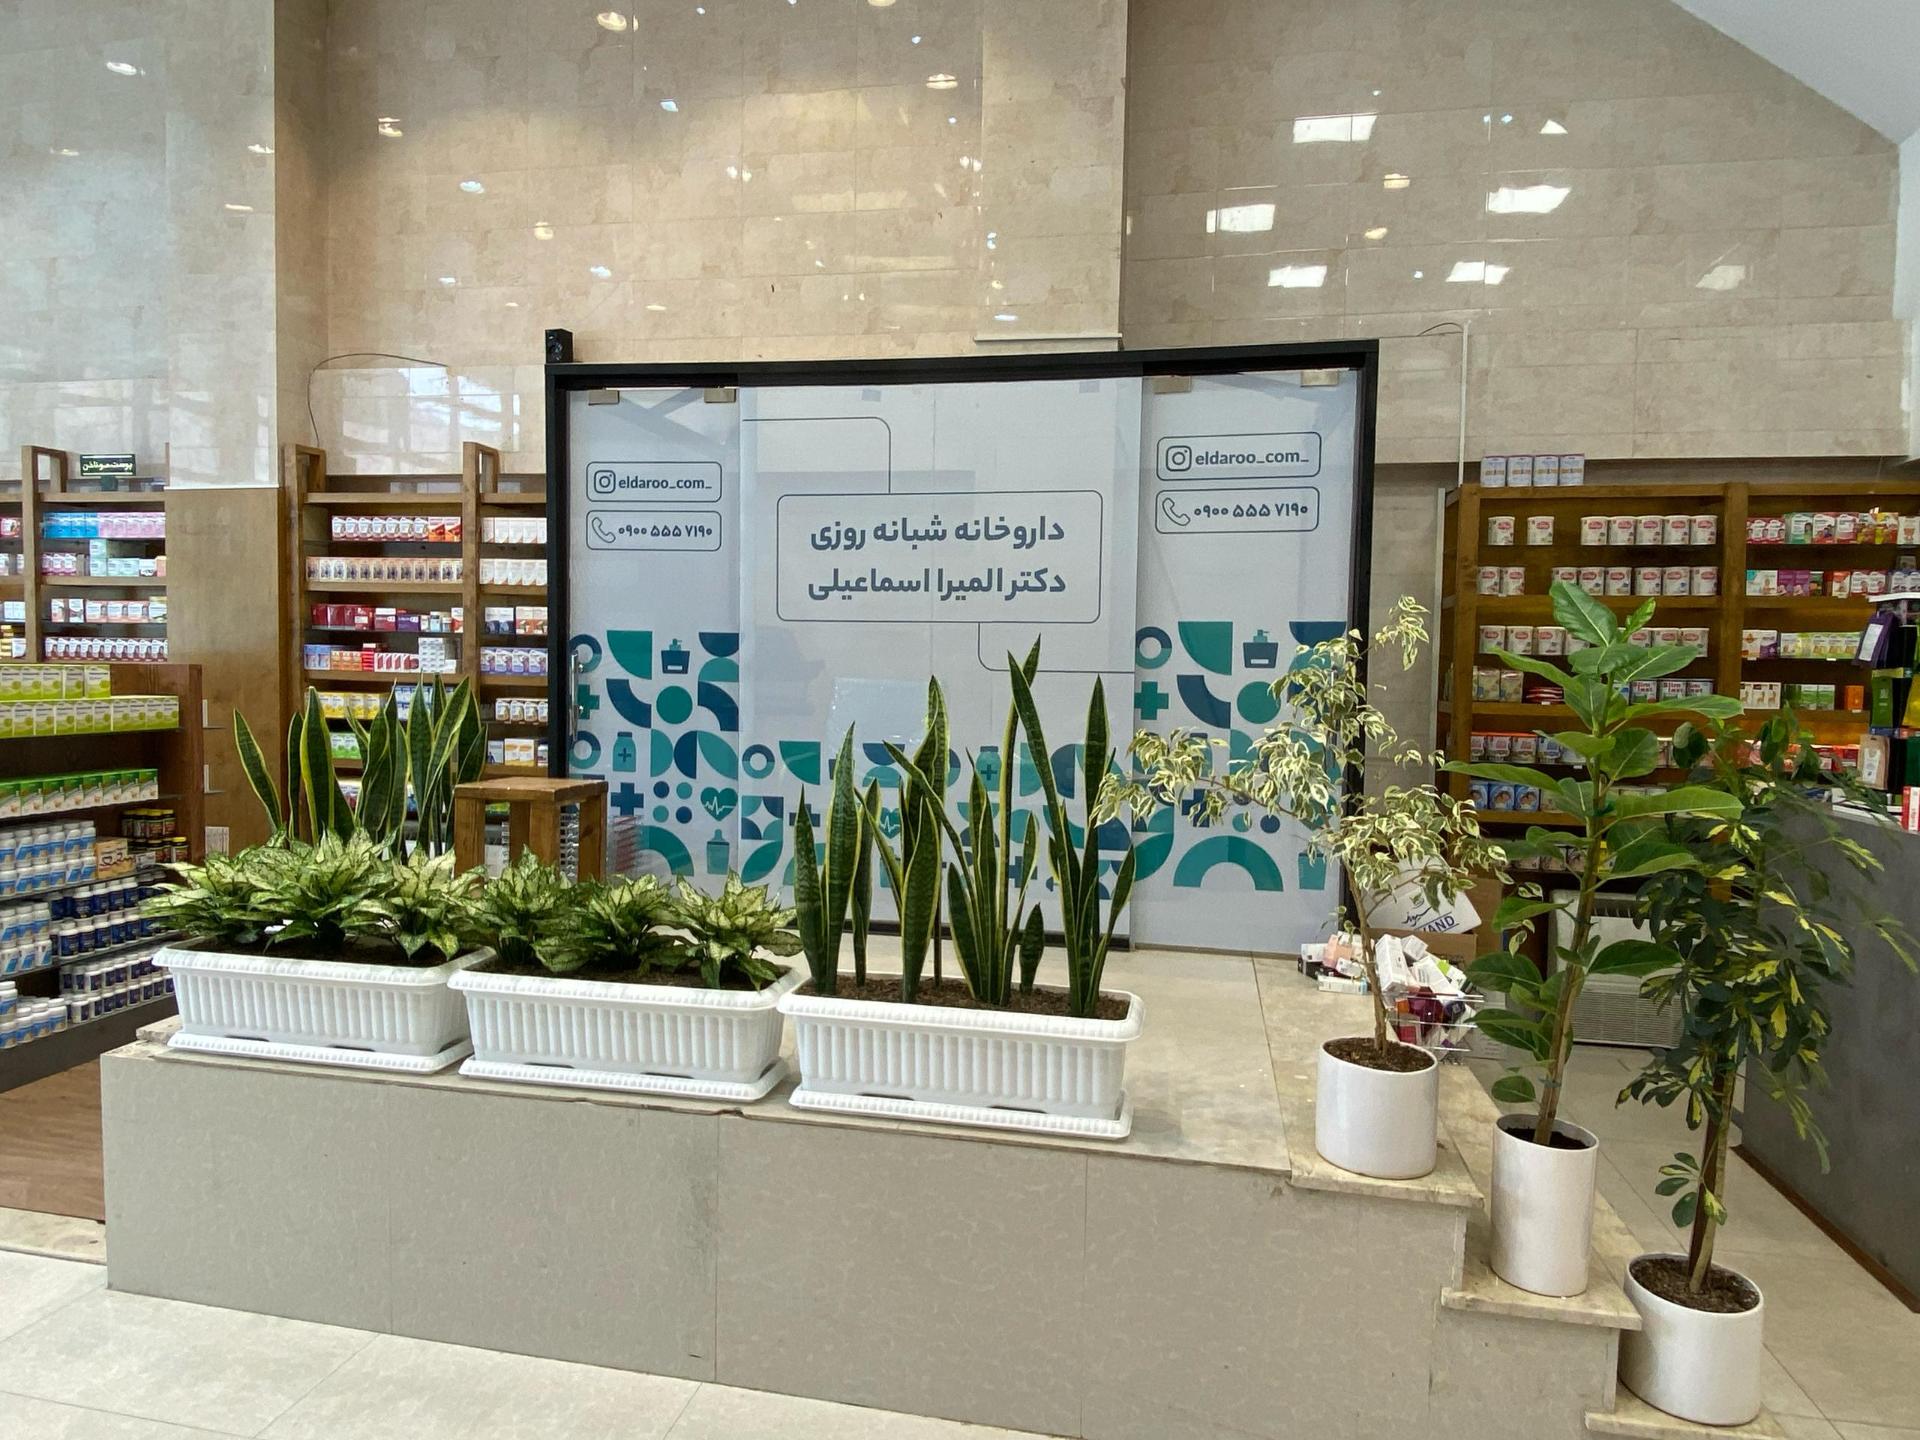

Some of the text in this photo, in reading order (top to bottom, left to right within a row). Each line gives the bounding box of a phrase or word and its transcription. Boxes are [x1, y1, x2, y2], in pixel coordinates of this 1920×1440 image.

[1195, 451, 1309, 466] eldaroo_com_
[618, 475, 713, 489] eldaroo_com_
[1194, 502, 1308, 518] ۰۹۰۰ ۵۵۵ ۷۱۹۰
[618, 524, 713, 538] ۰۹۰۰ ۵۵۵ ۷۱۹۰
[810, 514, 1065, 551] داروخانه شبانه روزی
[808, 567, 1066, 601] دکتر المیرا اسماعیلی
